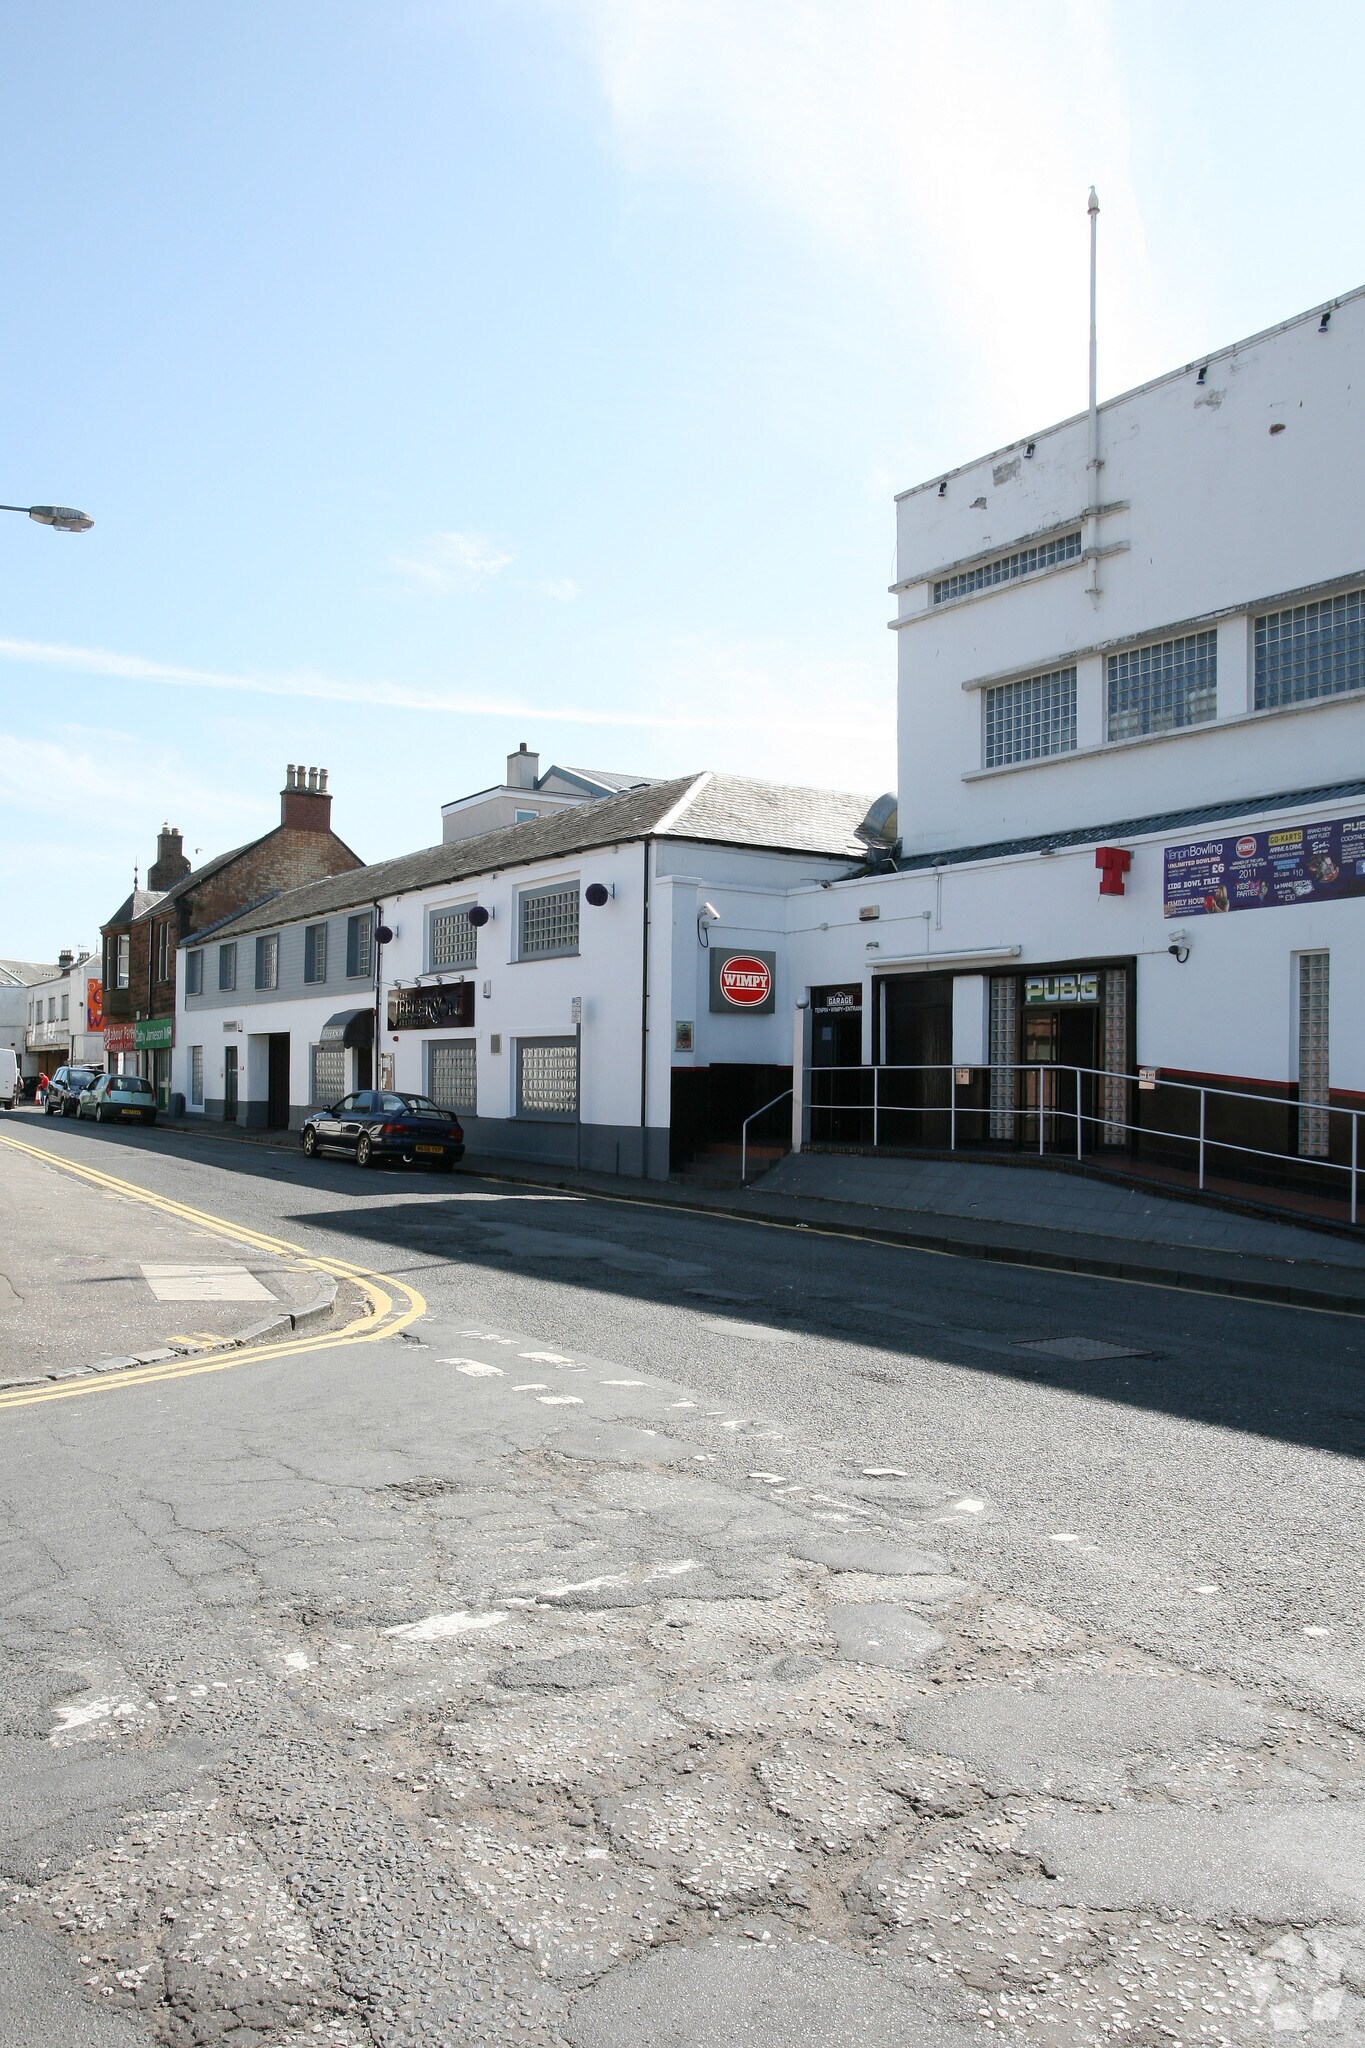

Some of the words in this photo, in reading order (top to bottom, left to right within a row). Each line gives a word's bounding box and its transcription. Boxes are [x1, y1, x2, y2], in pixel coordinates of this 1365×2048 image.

[1270, 832, 1302, 844] GO-KARTS
[1168, 860, 1195, 868] UNLIMITED
[1196, 856, 1220, 865] BOWLING
[1212, 863, 1225, 873] £6
[1238, 868, 1256, 879] 2011
[1167, 882, 1182, 890] KIDS
[1183, 879, 1201, 888] BOWL
[1203, 876, 1220, 886] FREE
[1236, 889, 1259, 898] PARTIES
[1167, 899, 1187, 908] FAMILY
[1187, 897, 1205, 906] HOUR
[723, 973, 768, 988] WIMPY
[828, 997, 852, 1005] GARAGE
